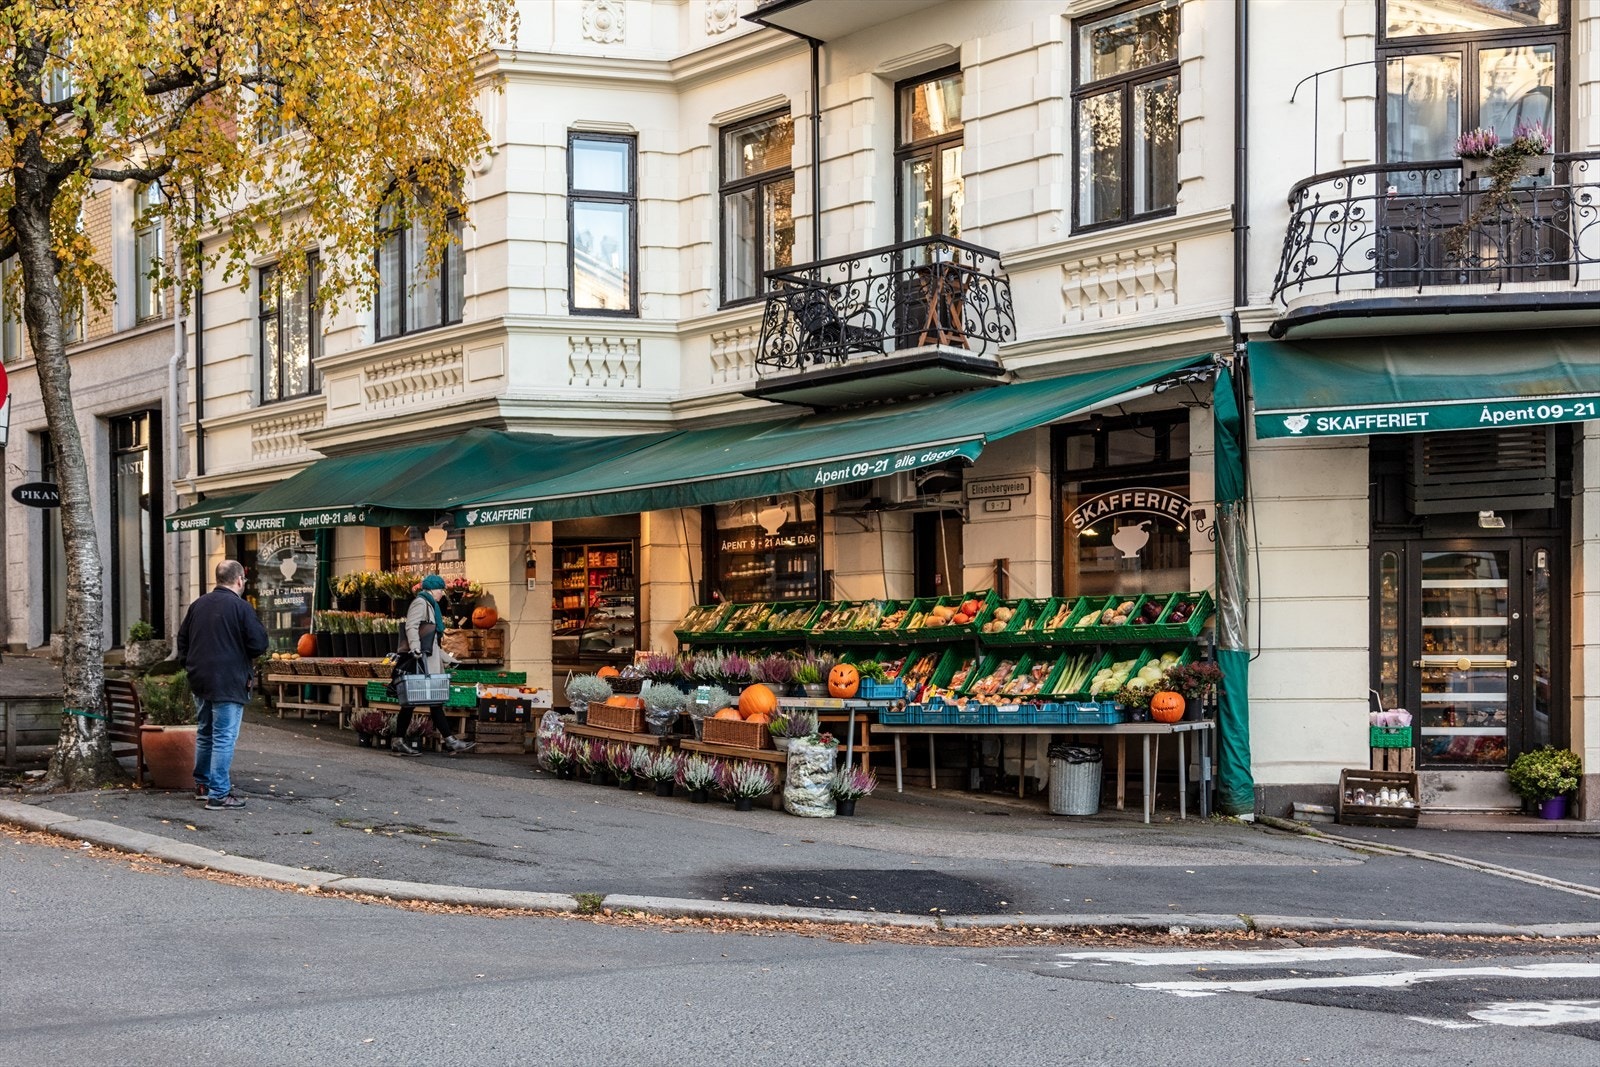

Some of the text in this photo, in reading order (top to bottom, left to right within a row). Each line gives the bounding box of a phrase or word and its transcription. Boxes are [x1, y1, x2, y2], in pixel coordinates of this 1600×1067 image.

[1316, 402, 1596, 432] SKAFFERIET Åpent 09-21
[814, 447, 961, 485] Åpent 09-21 alle dager
[20, 490, 59, 500] PIKAN
[971, 481, 1025, 495] Elisenbergveien
[480, 507, 534, 523] SKAFFERIET
[1072, 492, 1191, 530] SKAFFERIET
[180, 517, 211, 530] SKAFFERIET
[245, 517, 286, 530] SKAFFERIET
[299, 513, 320, 528] Åpent
[320, 512, 341, 525] 09-21
[343, 512, 357, 523] alle
[262, 534, 302, 560] SKAFFER
[721, 540, 748, 551] ÅPENT
[750, 540, 756, 548] 9
[764, 539, 774, 547] 21
[775, 536, 796, 546] ALLE
